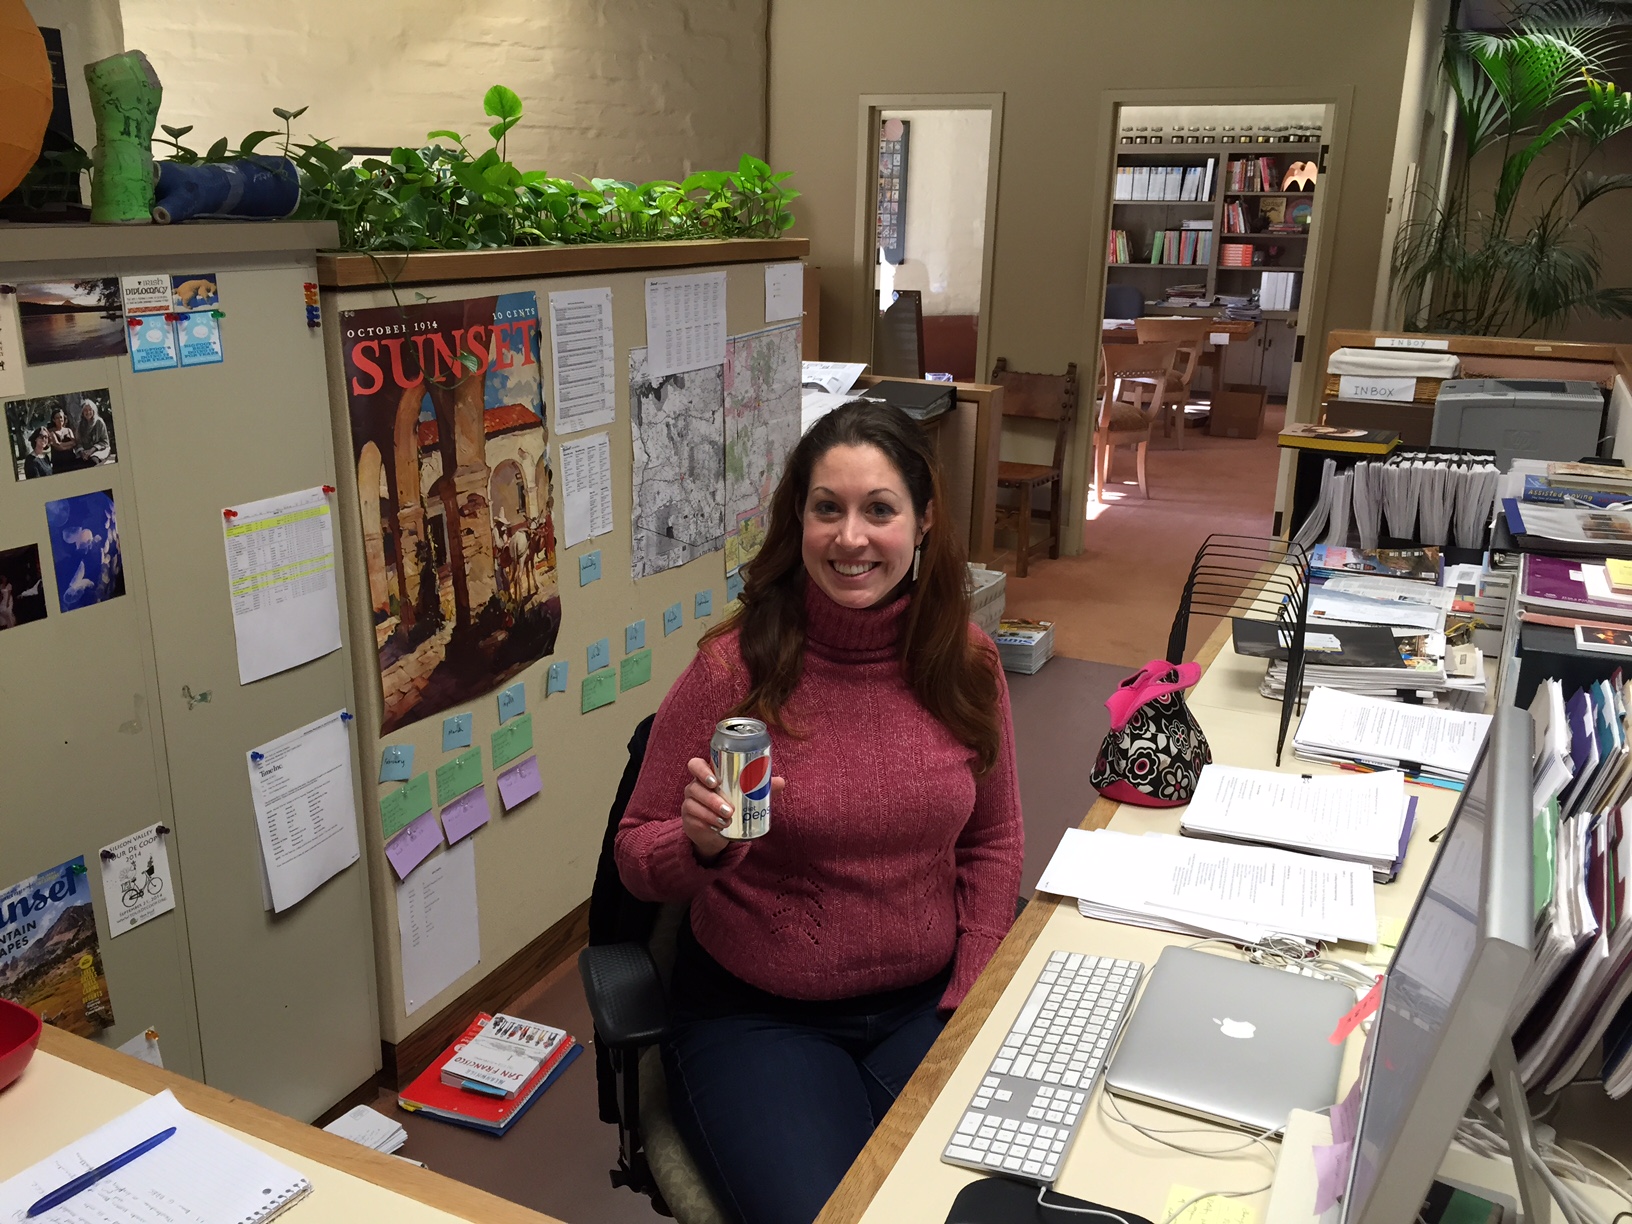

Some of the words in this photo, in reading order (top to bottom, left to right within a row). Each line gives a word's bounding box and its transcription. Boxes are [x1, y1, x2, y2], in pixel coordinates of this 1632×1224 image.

[492, 311, 503, 320] 10
[506, 307, 536, 318] CENTS
[1391, 339, 1427, 347] INBOX
[351, 319, 537, 396] SUNSET
[1354, 386, 1394, 398] INBOX
[1564, 493, 1594, 502] oving
[742, 805, 770, 823] peps
[133, 829, 154, 842] VALLEY
[108, 850, 127, 863] OUR
[128, 844, 138, 855] DE
[126, 852, 142, 863] 2014
[0, 865, 77, 929] nset
[0, 920, 37, 945] NTAIN
[0, 936, 29, 958] APES
[454, 1056, 500, 1075] FRANCISCO
[500, 1070, 524, 1081] SAN
